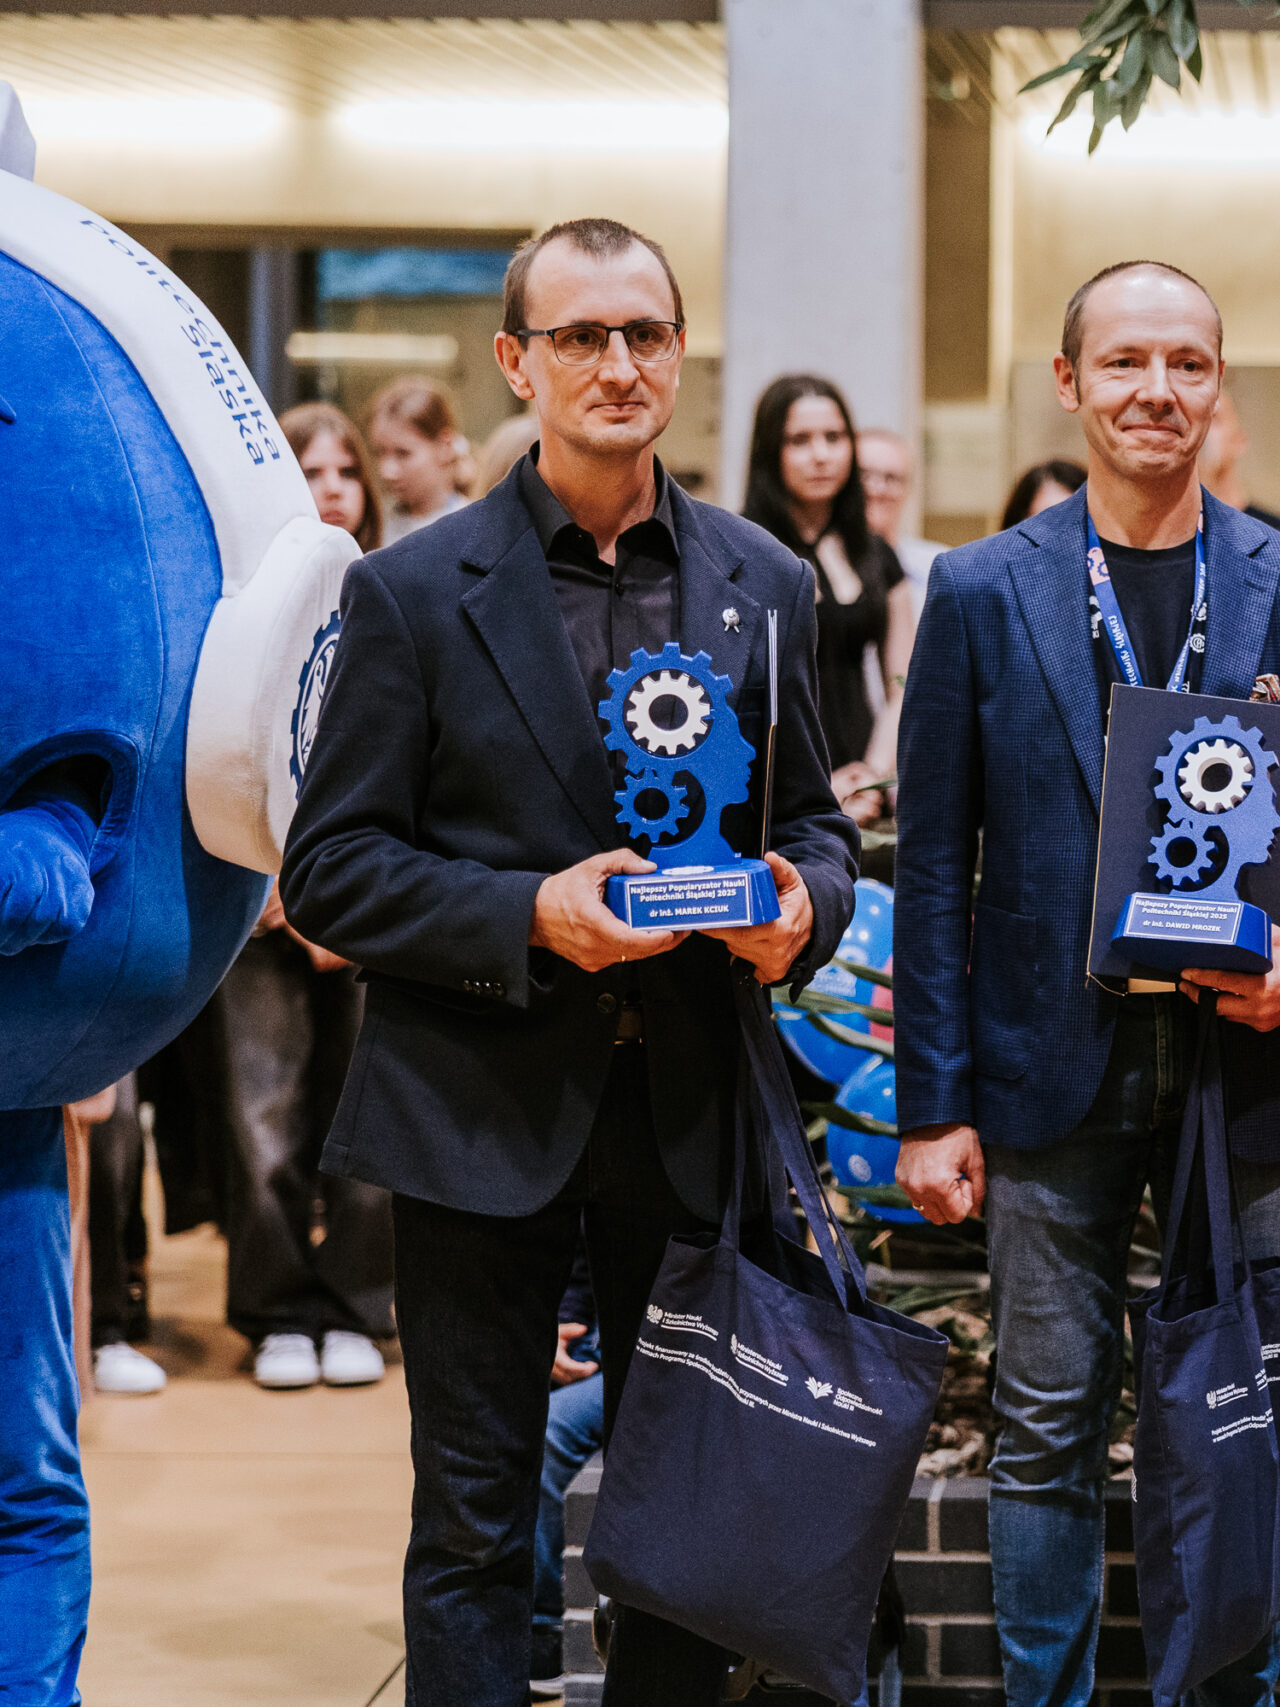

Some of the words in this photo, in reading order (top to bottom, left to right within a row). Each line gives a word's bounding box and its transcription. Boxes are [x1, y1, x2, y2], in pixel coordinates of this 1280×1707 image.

[630, 885, 667, 895] Najlepszy
[668, 881, 721, 892] Popularyzator
[722, 879, 745, 888] Nauki
[640, 892, 684, 903] Politechniki
[717, 889, 736, 898] 2025
[674, 906, 702, 916] MAREK
[704, 904, 729, 914] KCIUK
[1136, 900, 1168, 909] Najlepszy
[1169, 902, 1216, 912] Popularyzator
[1217, 905, 1237, 913] Nauki
[1142, 907, 1181, 916] Politechniki
[1210, 912, 1228, 920] 2025
[1165, 922, 1190, 930] DAWID
[1191, 923, 1221, 932] MROZEK
